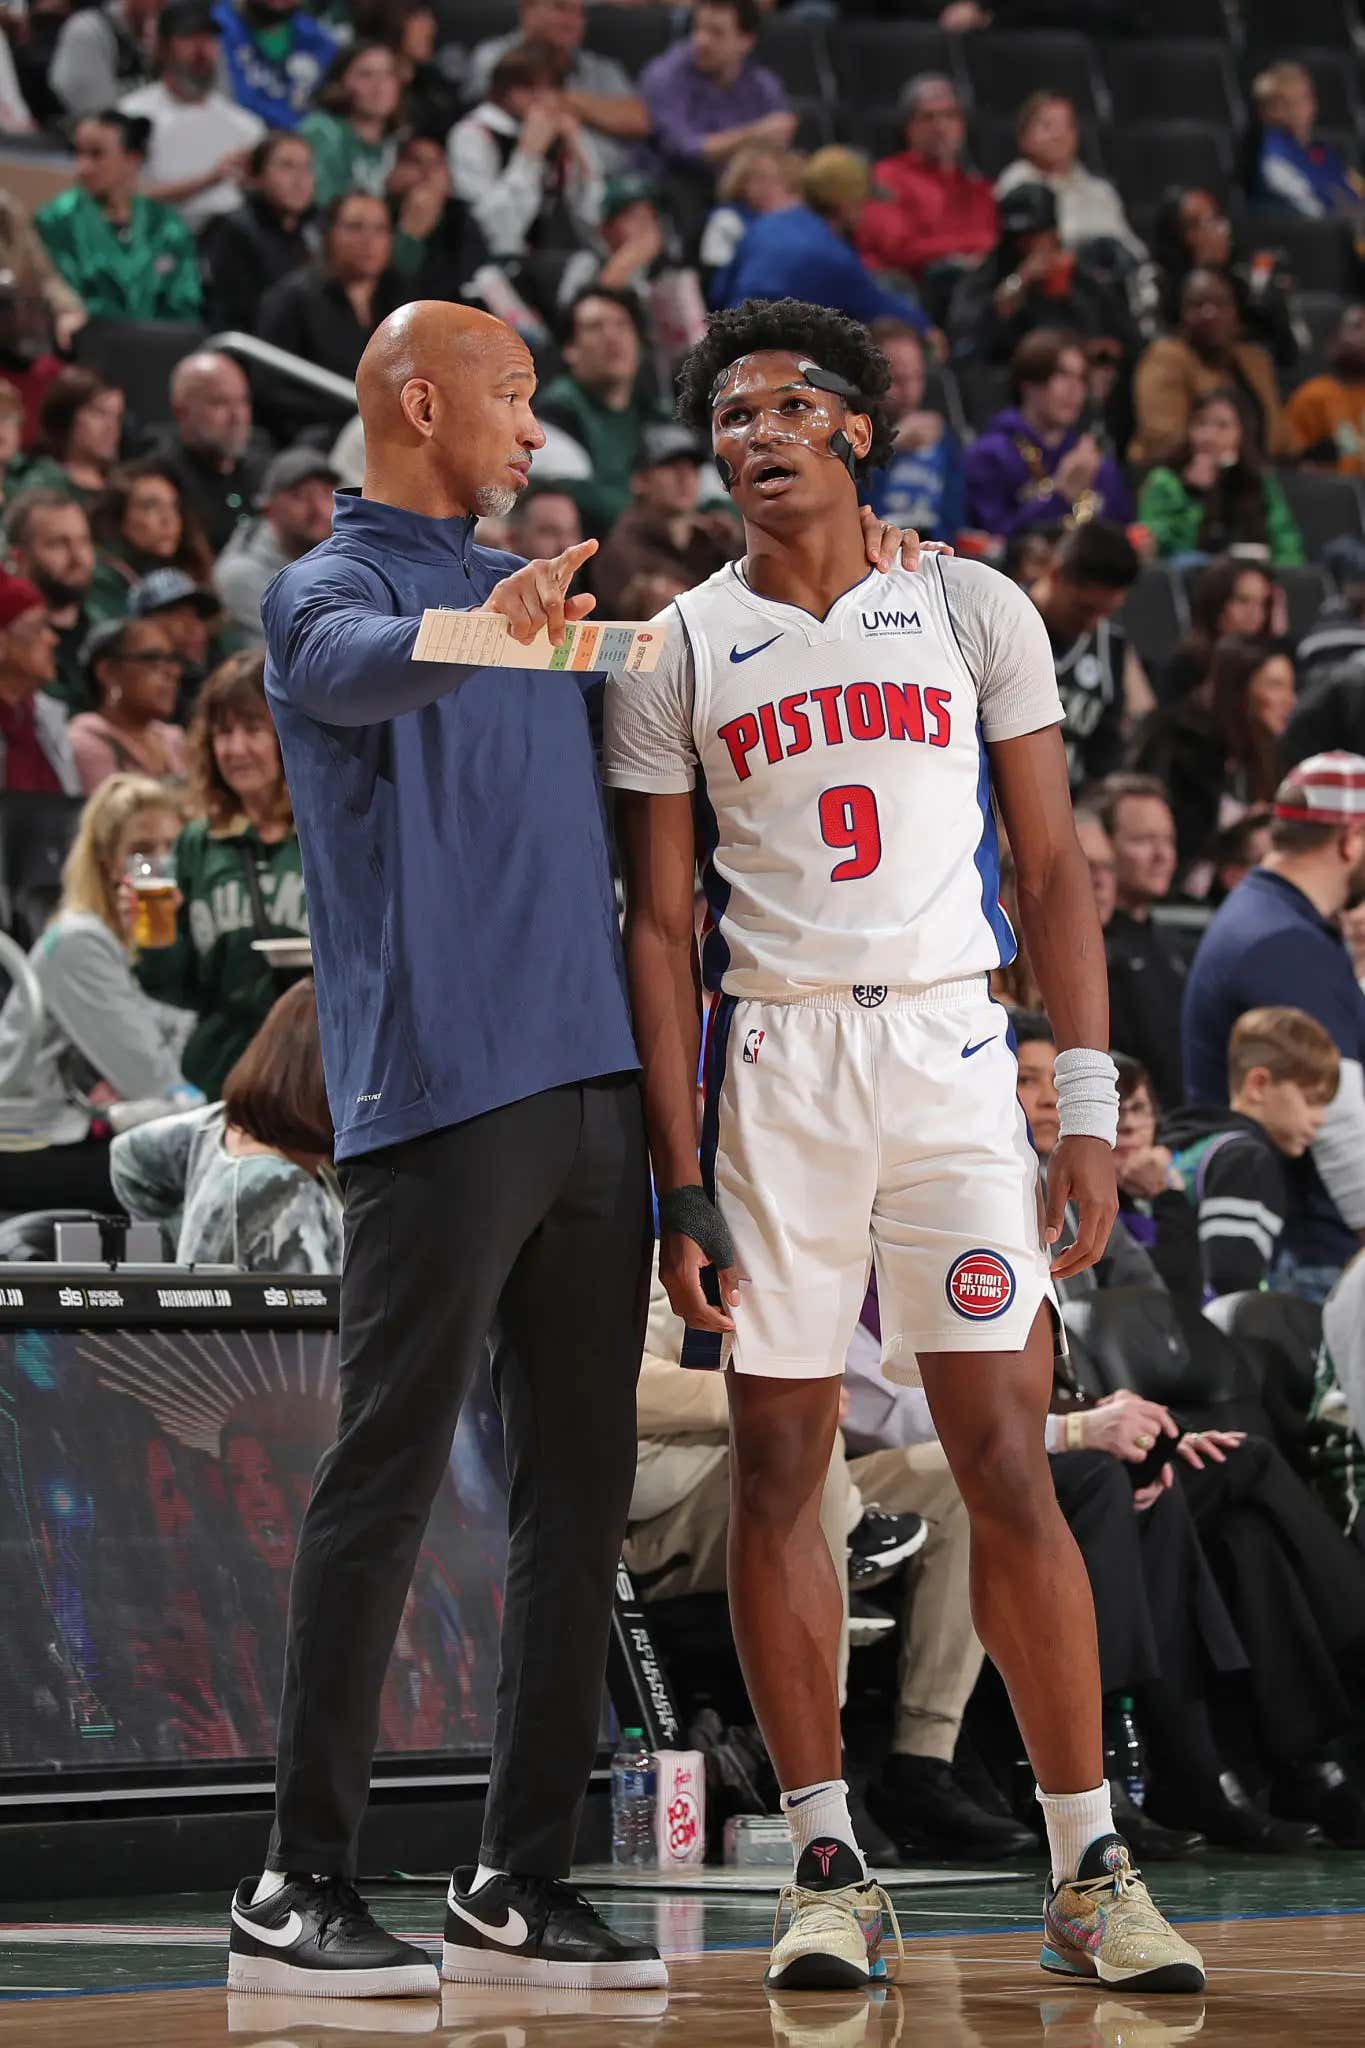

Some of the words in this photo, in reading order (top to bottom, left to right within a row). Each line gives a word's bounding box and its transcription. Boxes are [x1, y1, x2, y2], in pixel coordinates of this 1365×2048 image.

[862, 611, 921, 630] UWM
[717, 682, 952, 781] PISTONS
[818, 784, 882, 882] 9
[960, 1272, 1003, 1286] DETROIT
[959, 1284, 1002, 1298] PISTONS
